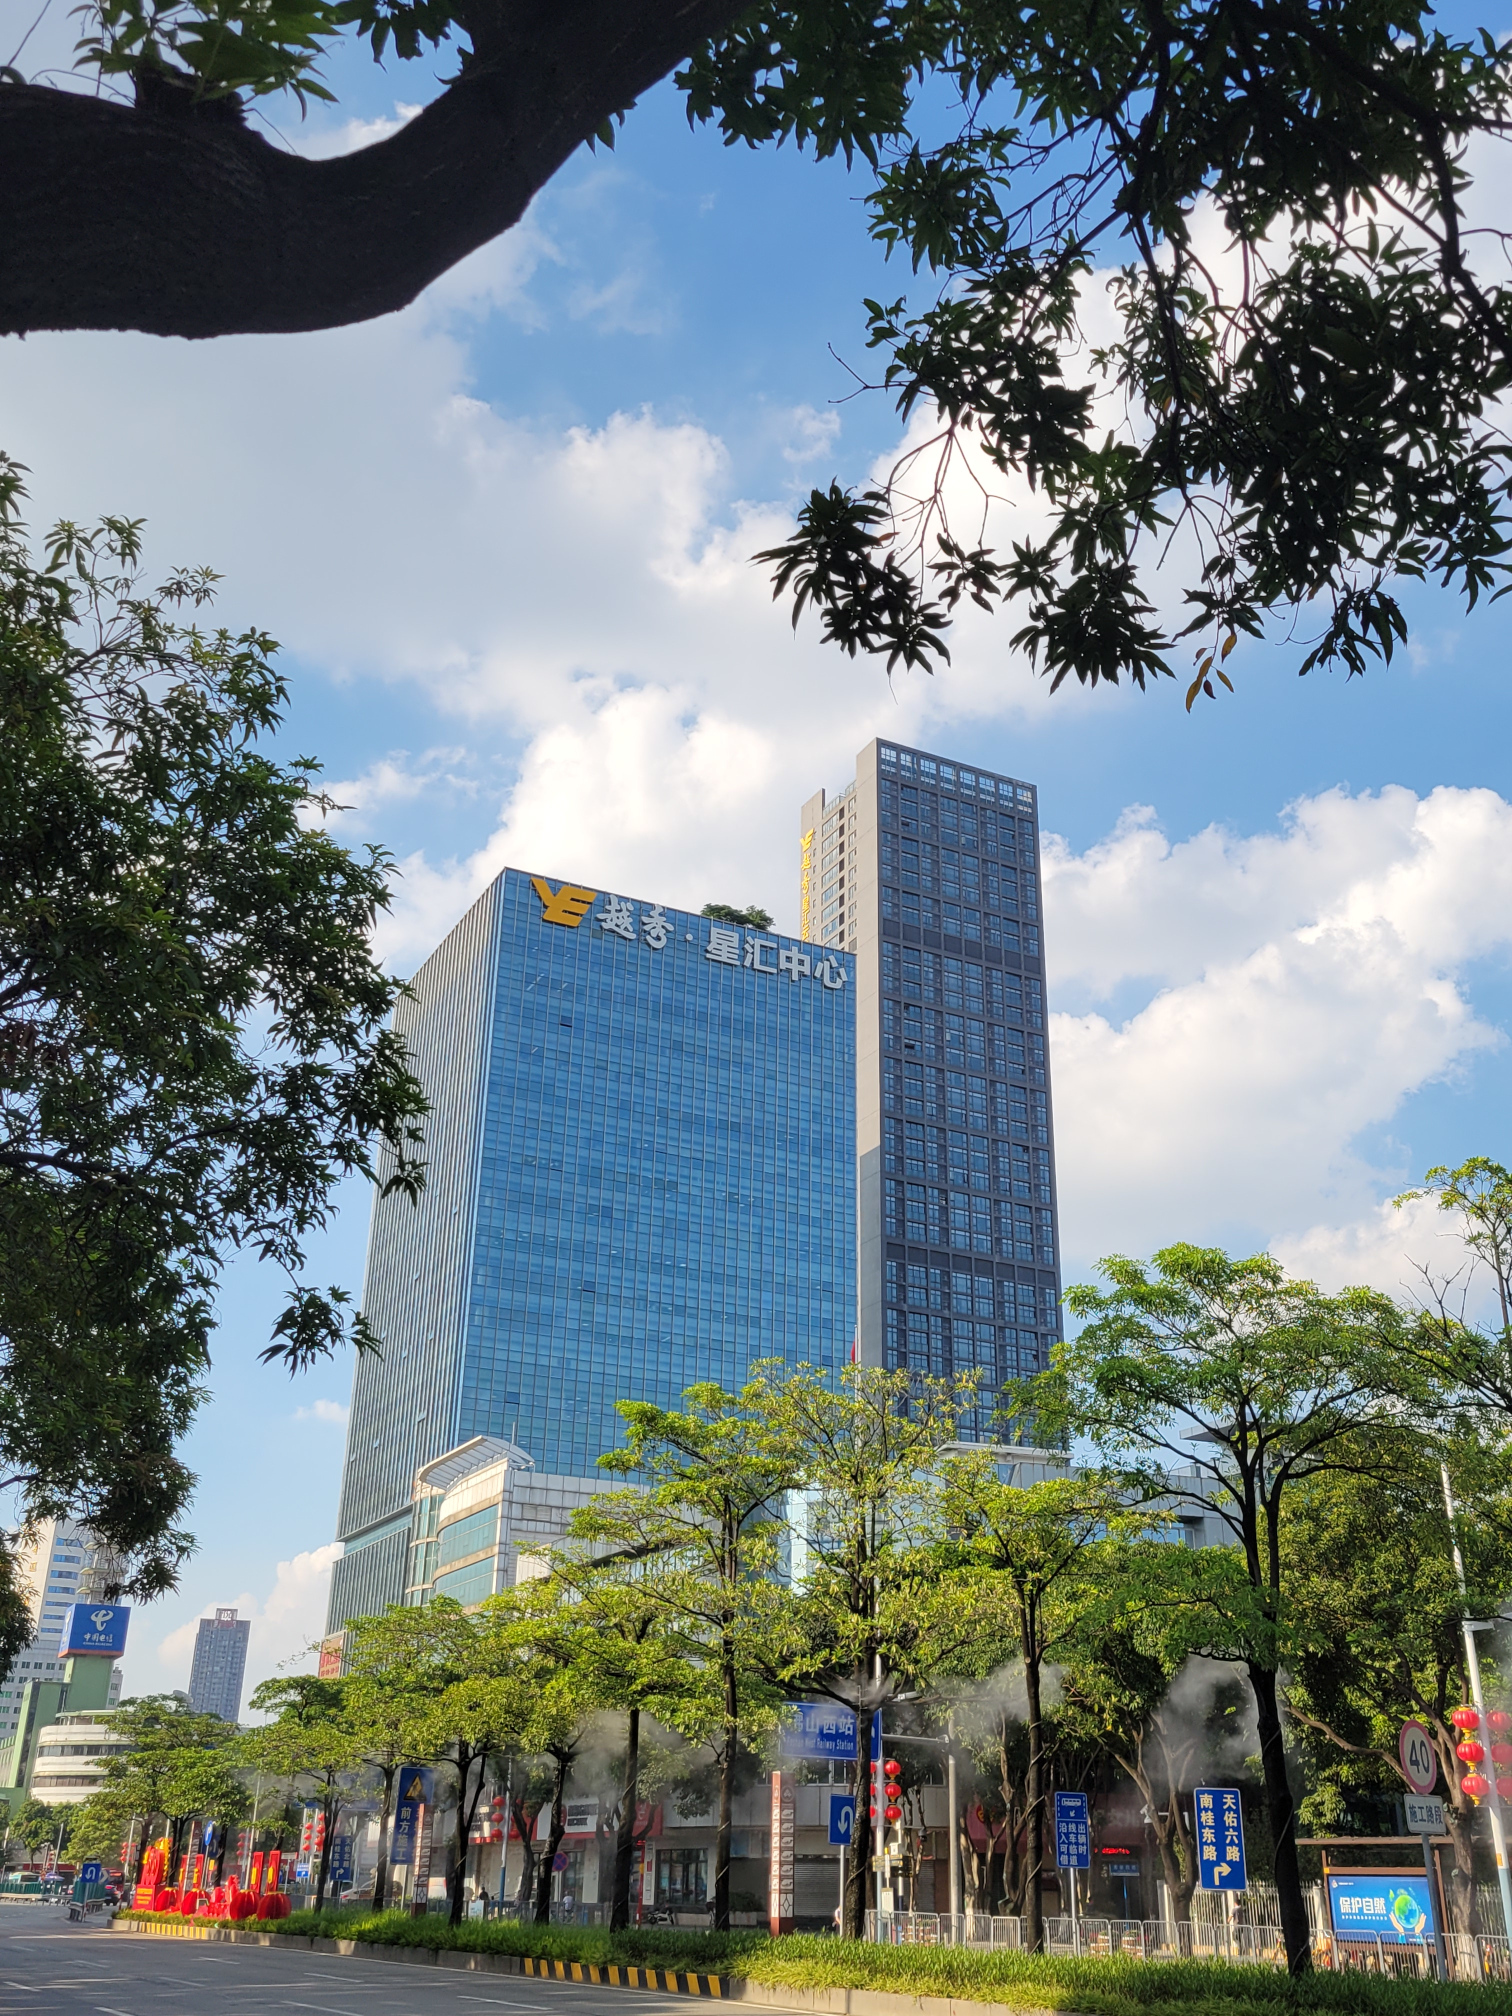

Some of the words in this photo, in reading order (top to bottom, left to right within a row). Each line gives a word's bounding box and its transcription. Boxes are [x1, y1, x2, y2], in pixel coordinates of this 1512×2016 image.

[84, 1632, 113, 1642] 中国电信
[816, 1738, 836, 1752] Railway
[836, 1740, 854, 1751] Station
[1410, 1739, 1430, 1774] 40
[1409, 1804, 1443, 1824] 施工路段
[395, 1807, 412, 1860] 前方施工
[1059, 1822, 1086, 1833] 沿线出
[1199, 1793, 1217, 1861] 南桂东路
[1222, 1794, 1240, 1862] 天佑六路
[1060, 1833, 1086, 1844] 入车辆
[1060, 1844, 1087, 1855] 可临时
[1060, 1855, 1078, 1866] 借道
[1340, 1896, 1386, 1914] 保护自然
